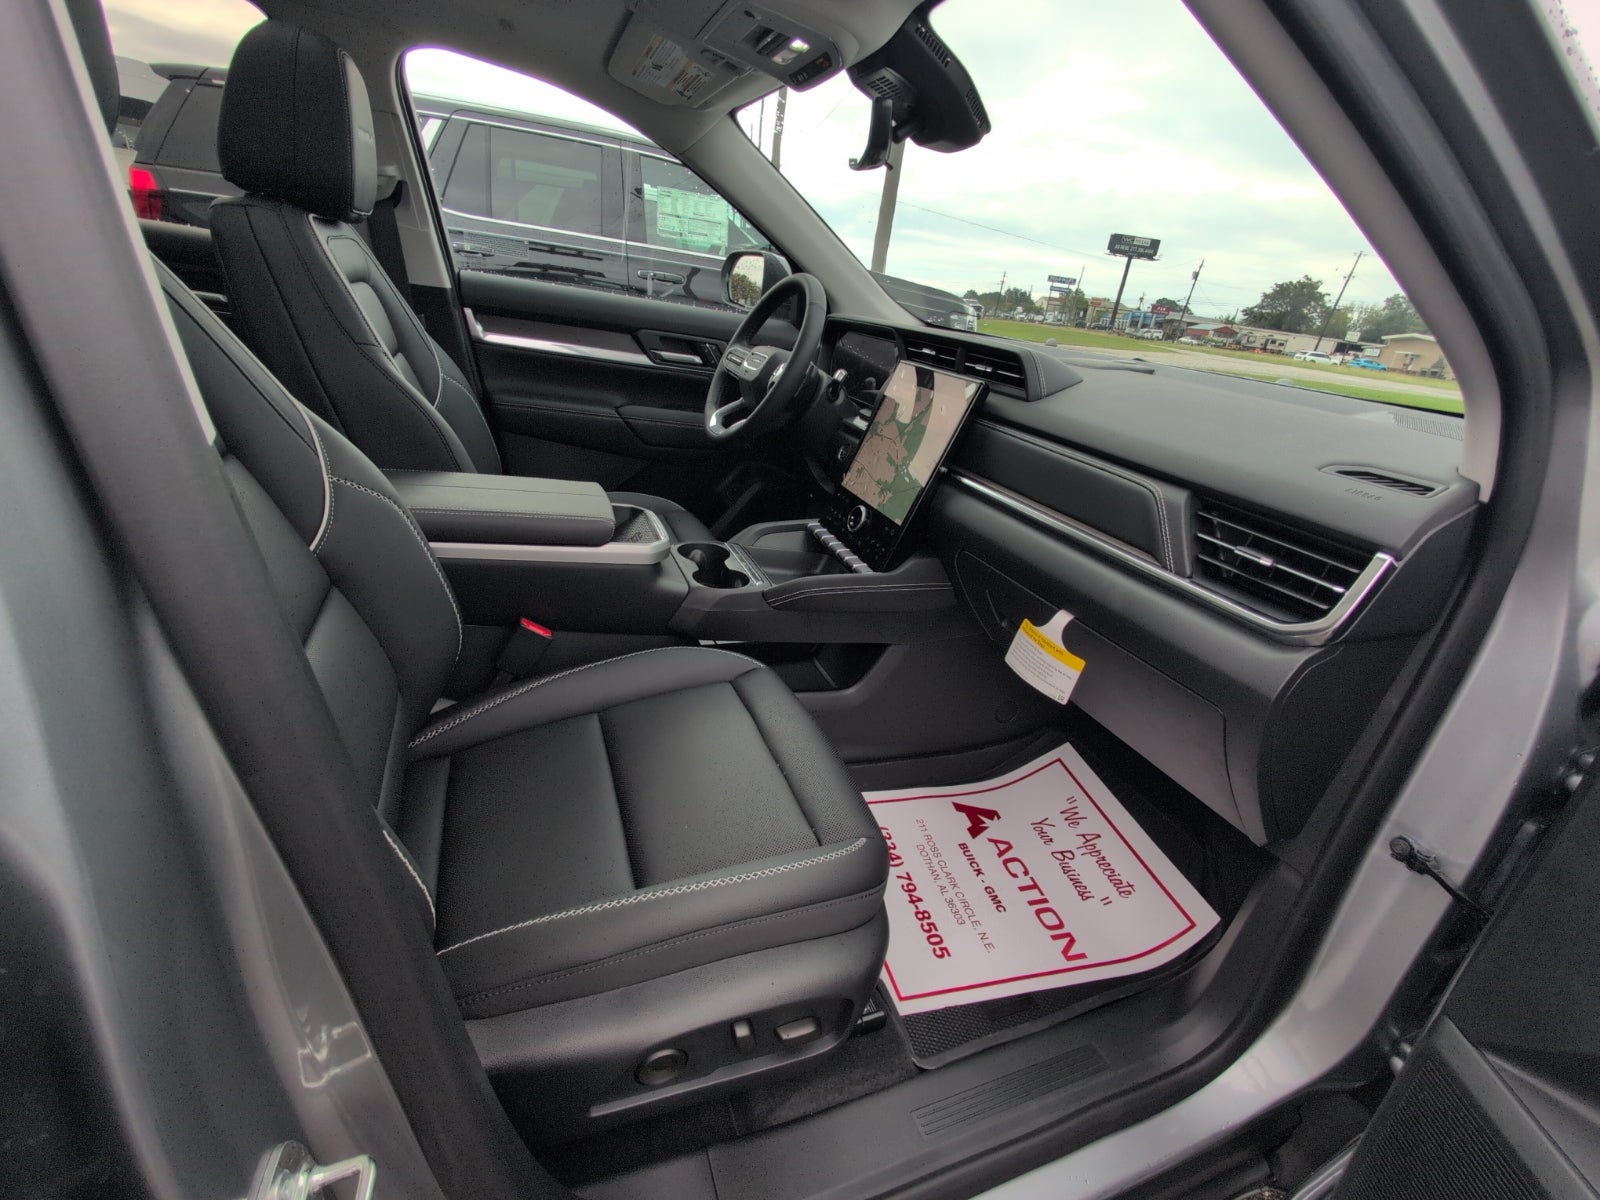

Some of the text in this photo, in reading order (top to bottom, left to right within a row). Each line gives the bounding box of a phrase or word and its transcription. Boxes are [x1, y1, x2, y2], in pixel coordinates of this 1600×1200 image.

[1030, 817, 1056, 846] Your
[1075, 833, 1136, 899] Appreciate
[896, 871, 953, 960] 794-8505
[915, 818, 996, 953] 211 ROSS CLARK CIRCLE, N.E.
[916, 844, 966, 926] DOTHAN, AL 36303
[957, 842, 985, 878] BUICK
[984, 885, 1007, 913] GMC
[987, 837, 1089, 962] ACTION
